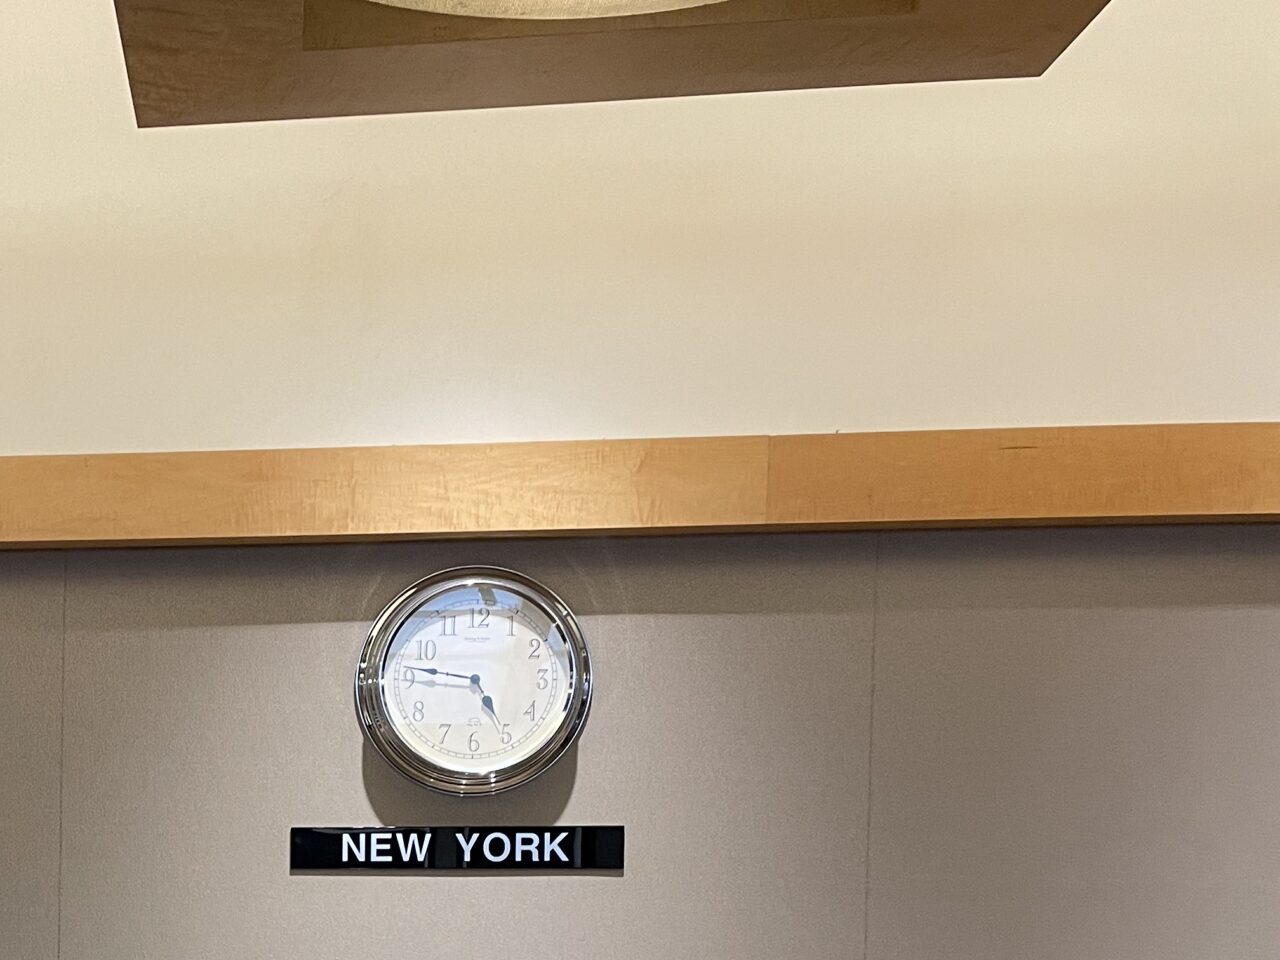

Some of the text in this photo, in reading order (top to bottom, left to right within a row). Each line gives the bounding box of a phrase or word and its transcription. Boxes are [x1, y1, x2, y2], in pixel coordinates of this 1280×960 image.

[439, 615, 457, 637] 11
[469, 608, 491, 629] 12
[506, 615, 517, 637] 1
[414, 639, 437, 661] 10
[528, 638, 541, 659] 2
[403, 668, 415, 689] 9
[536, 669, 548, 690] 3
[412, 701, 425, 722] 8
[523, 700, 536, 722] 4
[438, 724, 451, 744] 7
[469, 731, 480, 752] 6
[501, 723, 512, 745] 5
[341, 831, 569, 862] NEW YORK
